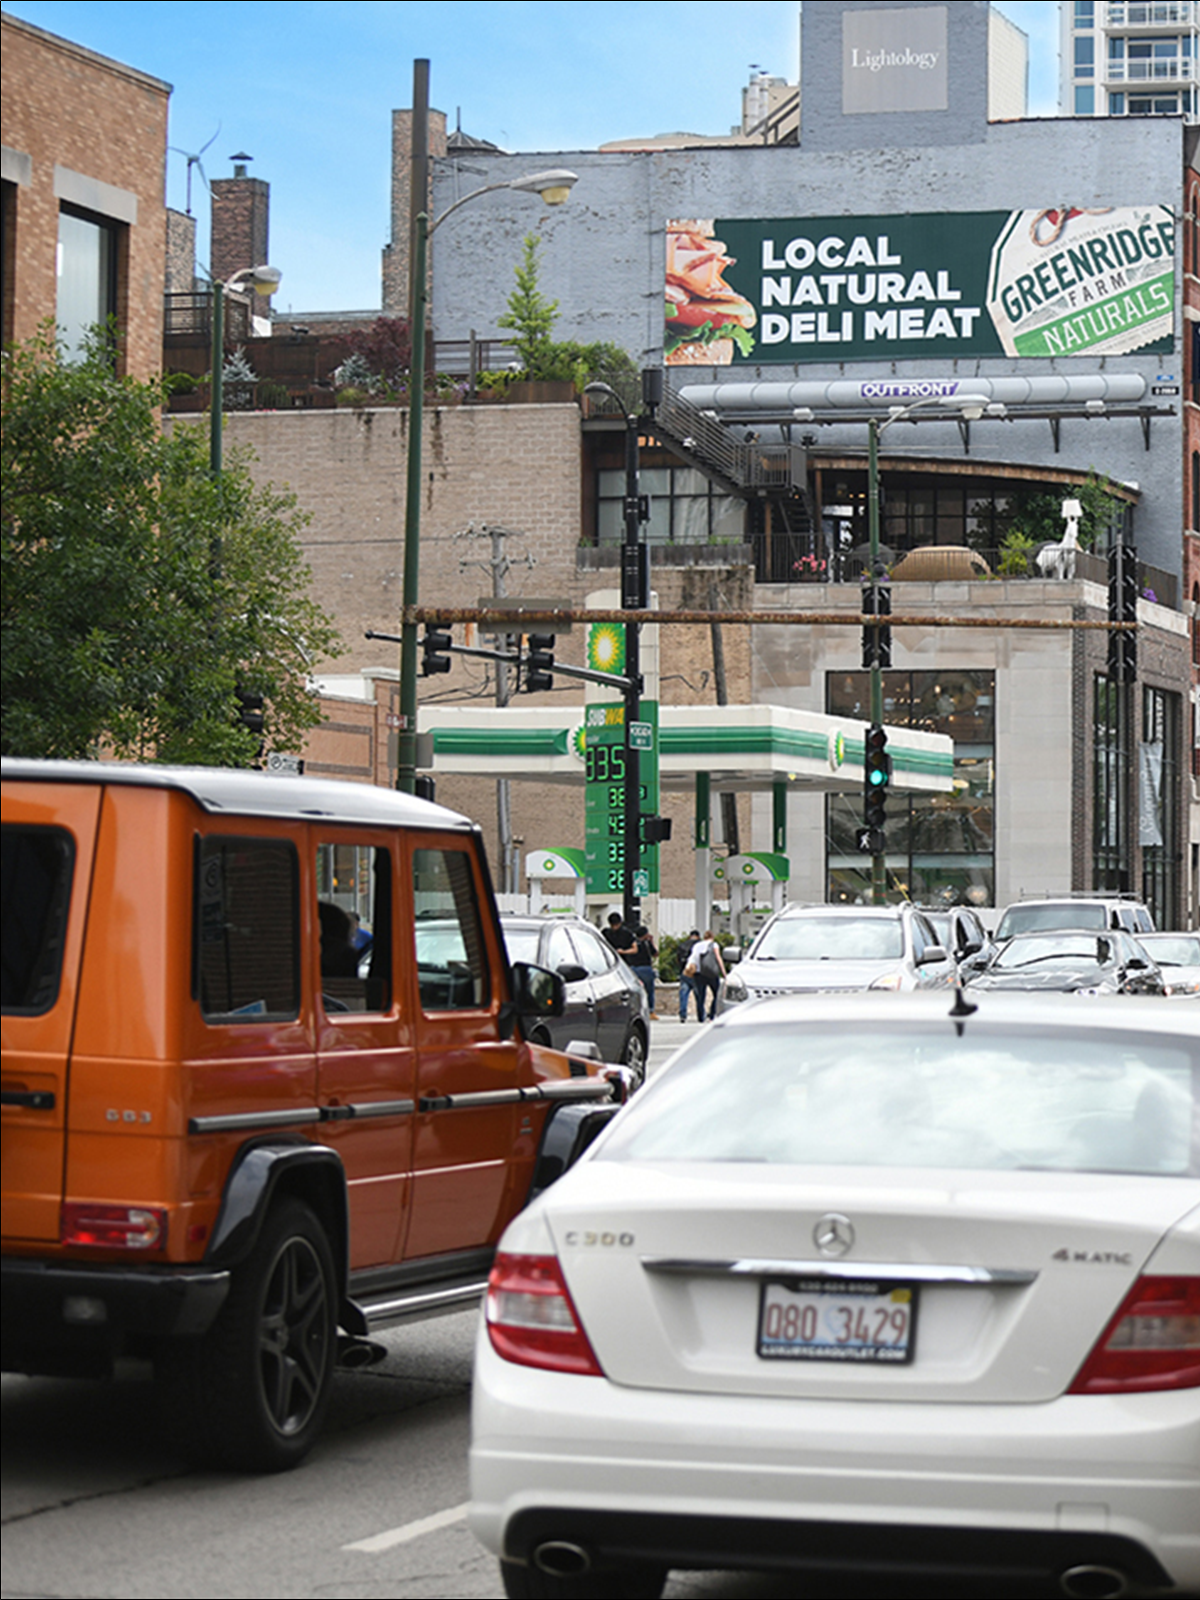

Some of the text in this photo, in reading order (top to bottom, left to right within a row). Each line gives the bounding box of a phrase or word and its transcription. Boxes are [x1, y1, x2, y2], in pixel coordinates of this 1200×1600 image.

[852, 48, 939, 72] Lightology
[762, 236, 901, 269] LOCAL
[762, 271, 961, 306] NATURAL
[1001, 221, 1174, 323] GREENRIDGE
[1068, 272, 1127, 307] FARM
[761, 307, 981, 344] DELI MEAT
[1042, 282, 1170, 355] NATURALS
[863, 383, 955, 397] OUTFRONT
[587, 707, 624, 727] SUBWA
[566, 1231, 635, 1246] C 300
[835, 1305, 907, 1345] 3429
